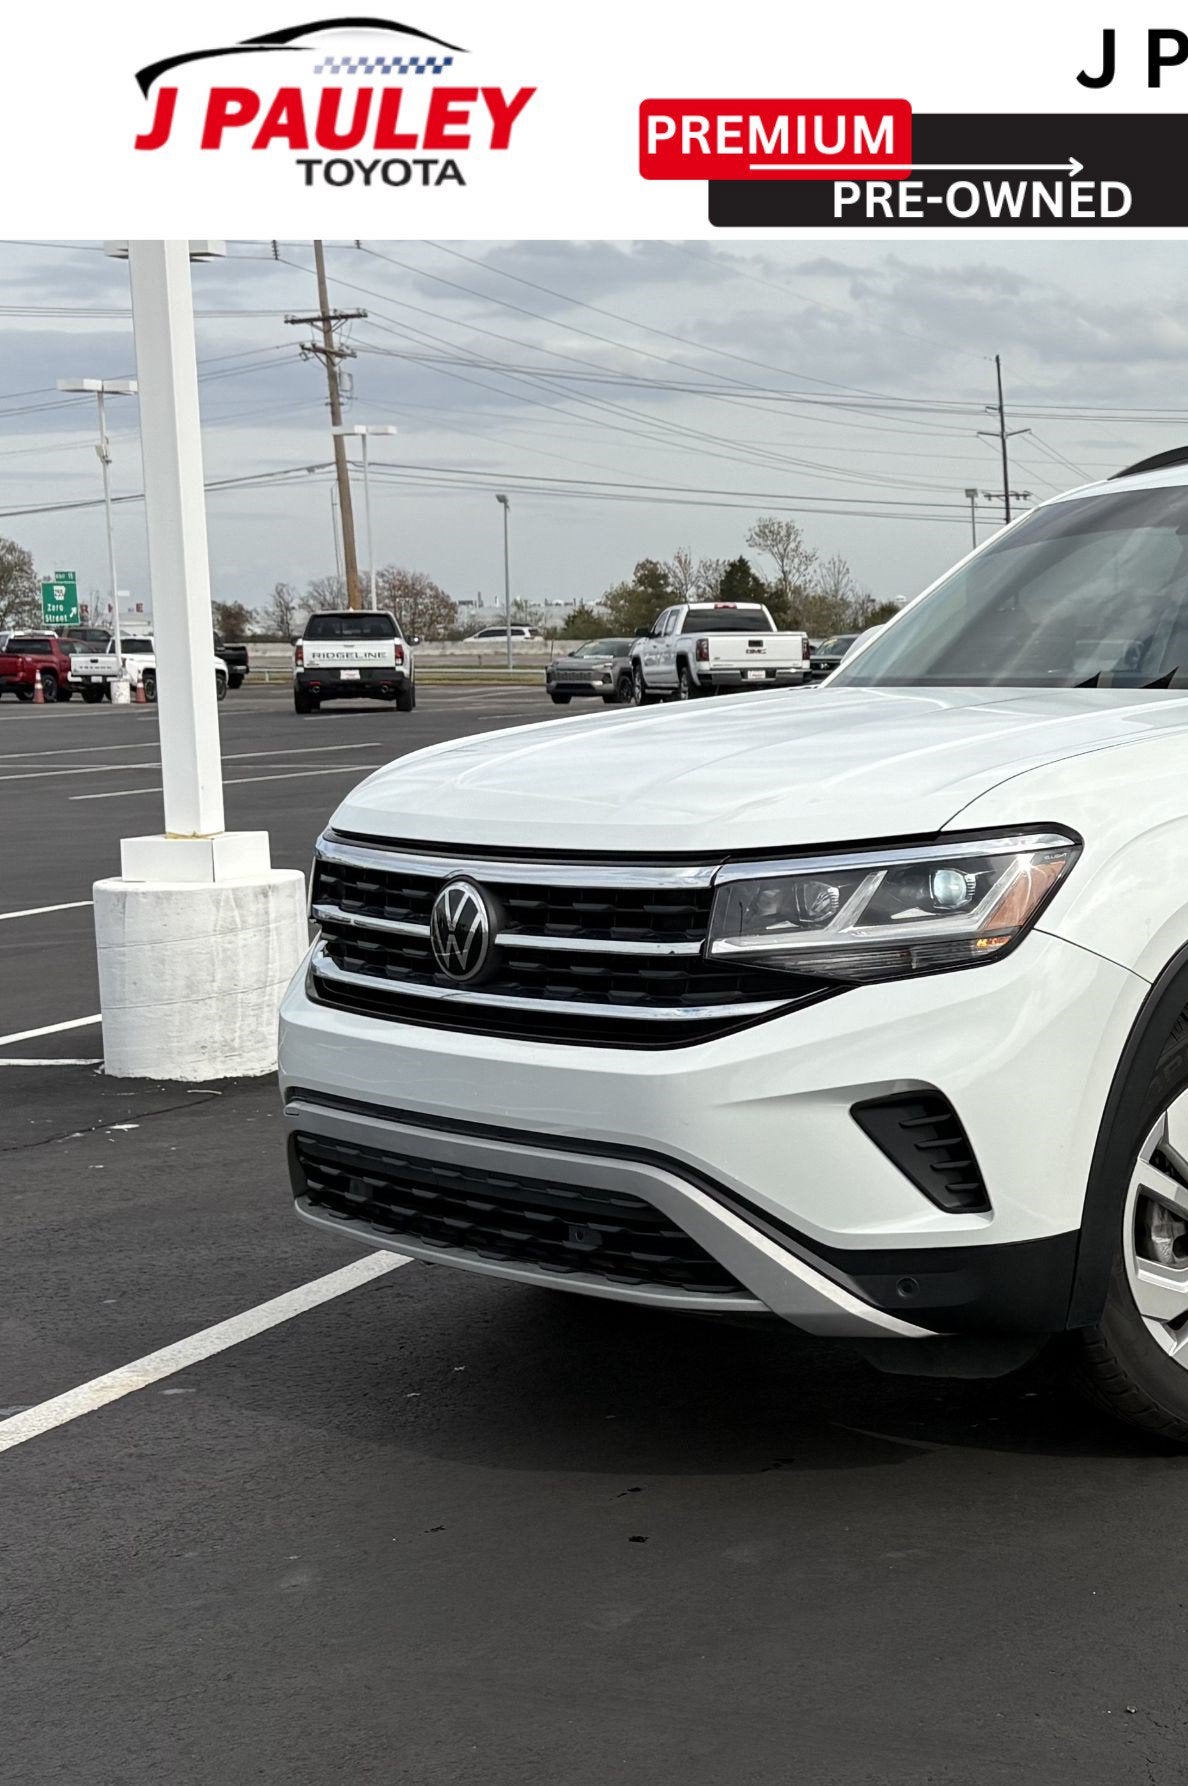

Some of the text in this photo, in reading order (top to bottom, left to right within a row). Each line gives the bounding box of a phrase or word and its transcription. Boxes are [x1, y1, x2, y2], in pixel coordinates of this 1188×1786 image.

[47, 603, 64, 613] Zero
[45, 614, 68, 623] Street
[311, 651, 387, 659] RIDGELINE
